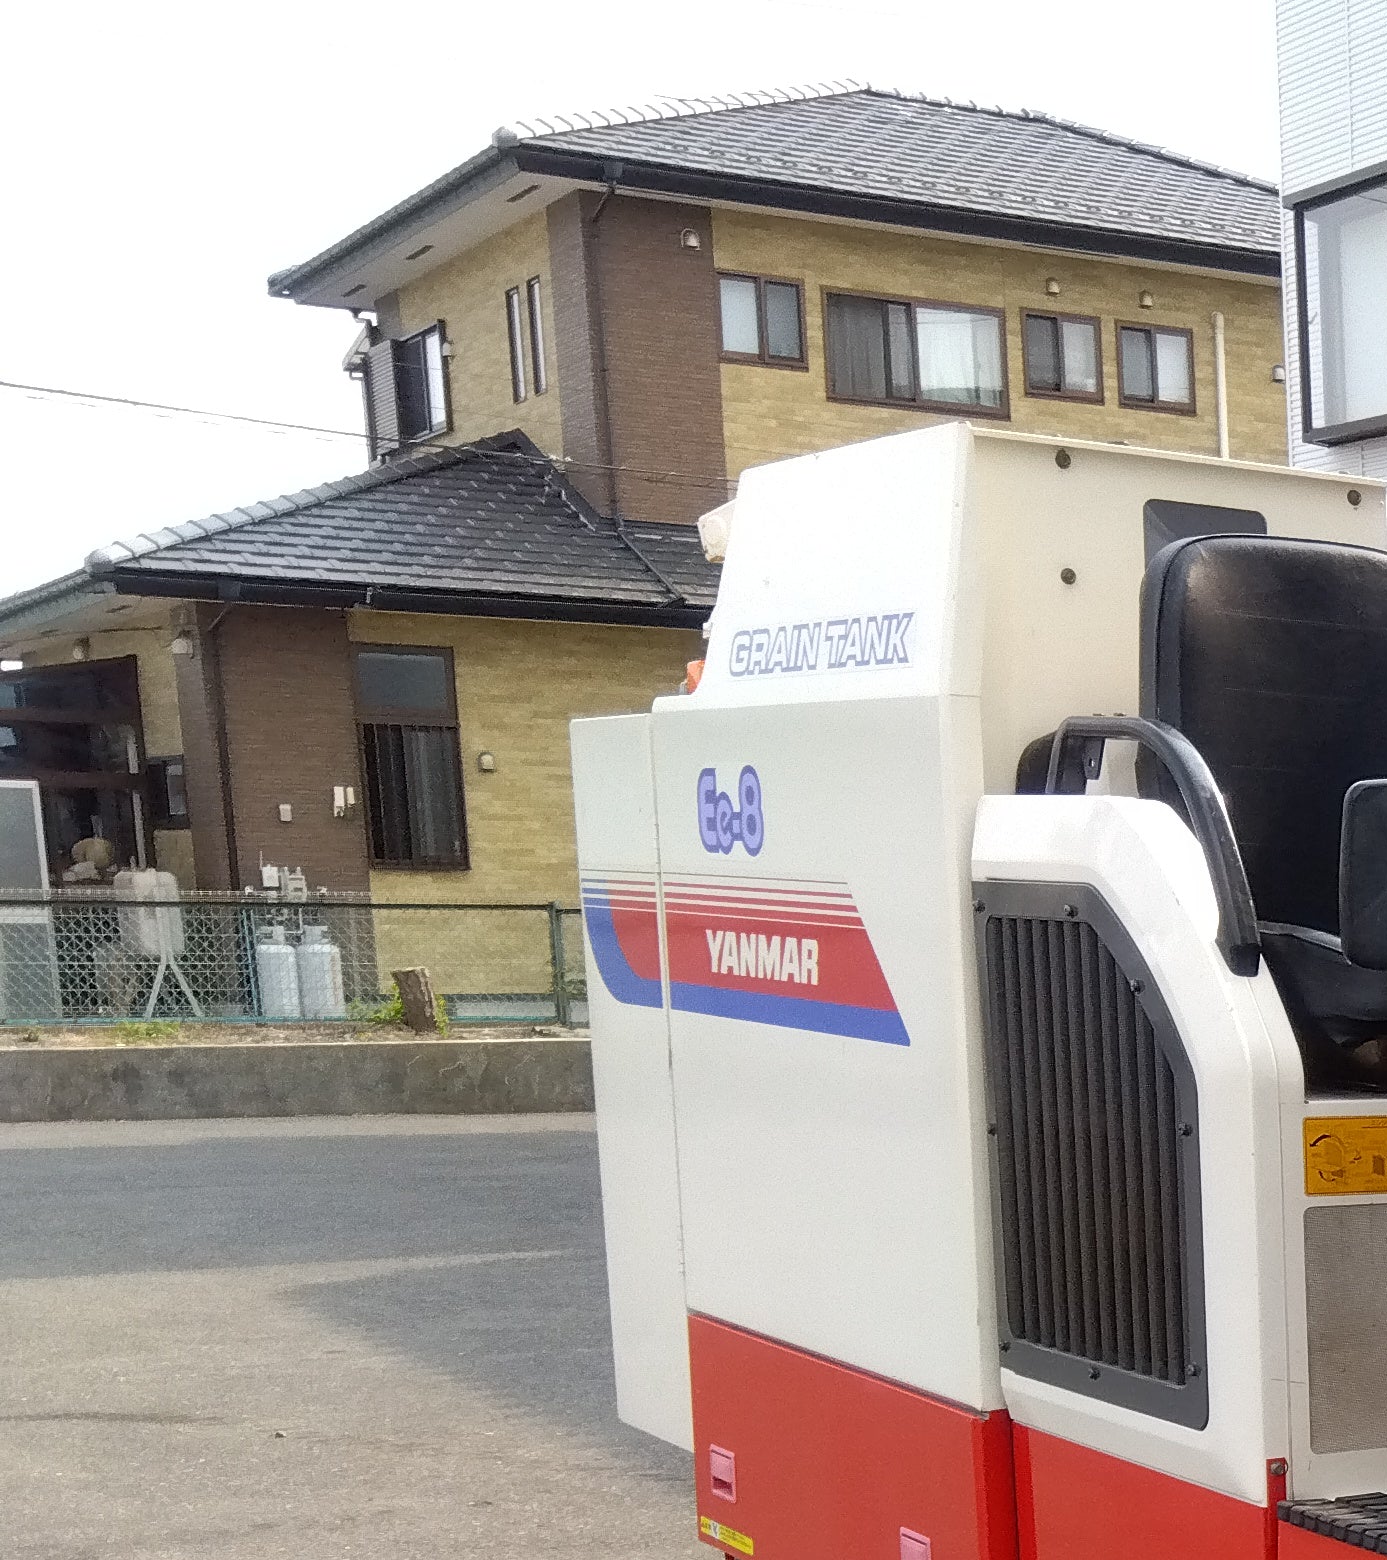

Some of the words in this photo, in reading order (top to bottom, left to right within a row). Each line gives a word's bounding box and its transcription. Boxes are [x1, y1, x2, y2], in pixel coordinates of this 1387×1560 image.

[730, 622, 821, 677] GRAIN
[825, 612, 915, 670] TANK
[697, 765, 764, 857] Ee-8
[705, 928, 819, 986] YANMAR
